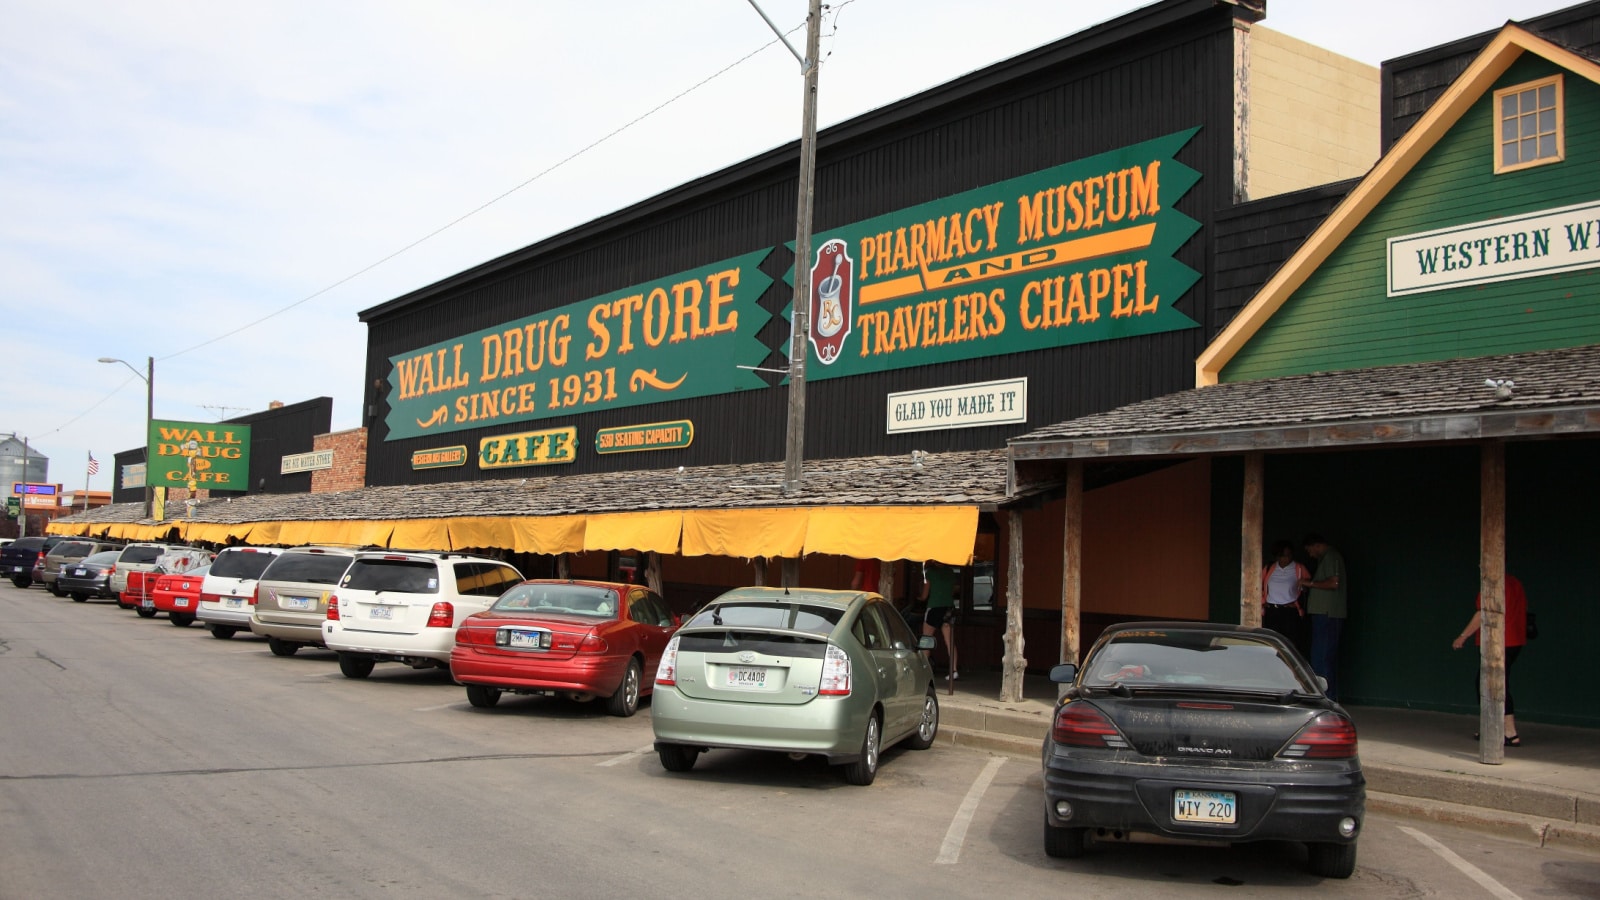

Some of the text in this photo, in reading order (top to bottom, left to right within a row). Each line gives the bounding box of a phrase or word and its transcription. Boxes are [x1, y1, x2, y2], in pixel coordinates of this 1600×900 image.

[859, 160, 1161, 281] PHARMACY MUSEUM
[1416, 217, 1600, 276] WESTERN W
[943, 248, 1057, 283] AND
[857, 259, 1160, 358] TRAVELERS CHAPEL
[397, 266, 740, 401] WALL DRUG STORE
[454, 367, 617, 424] SINCE 1931
[895, 391, 1016, 421] GLAD YOU MADE IT
[159, 427, 242, 444] WALL
[482, 432, 569, 464] CAFE
[615, 430, 645, 447] SEATING
[645, 427, 683, 444] CAPACITY
[1178, 800, 1231, 818] WIY 220
